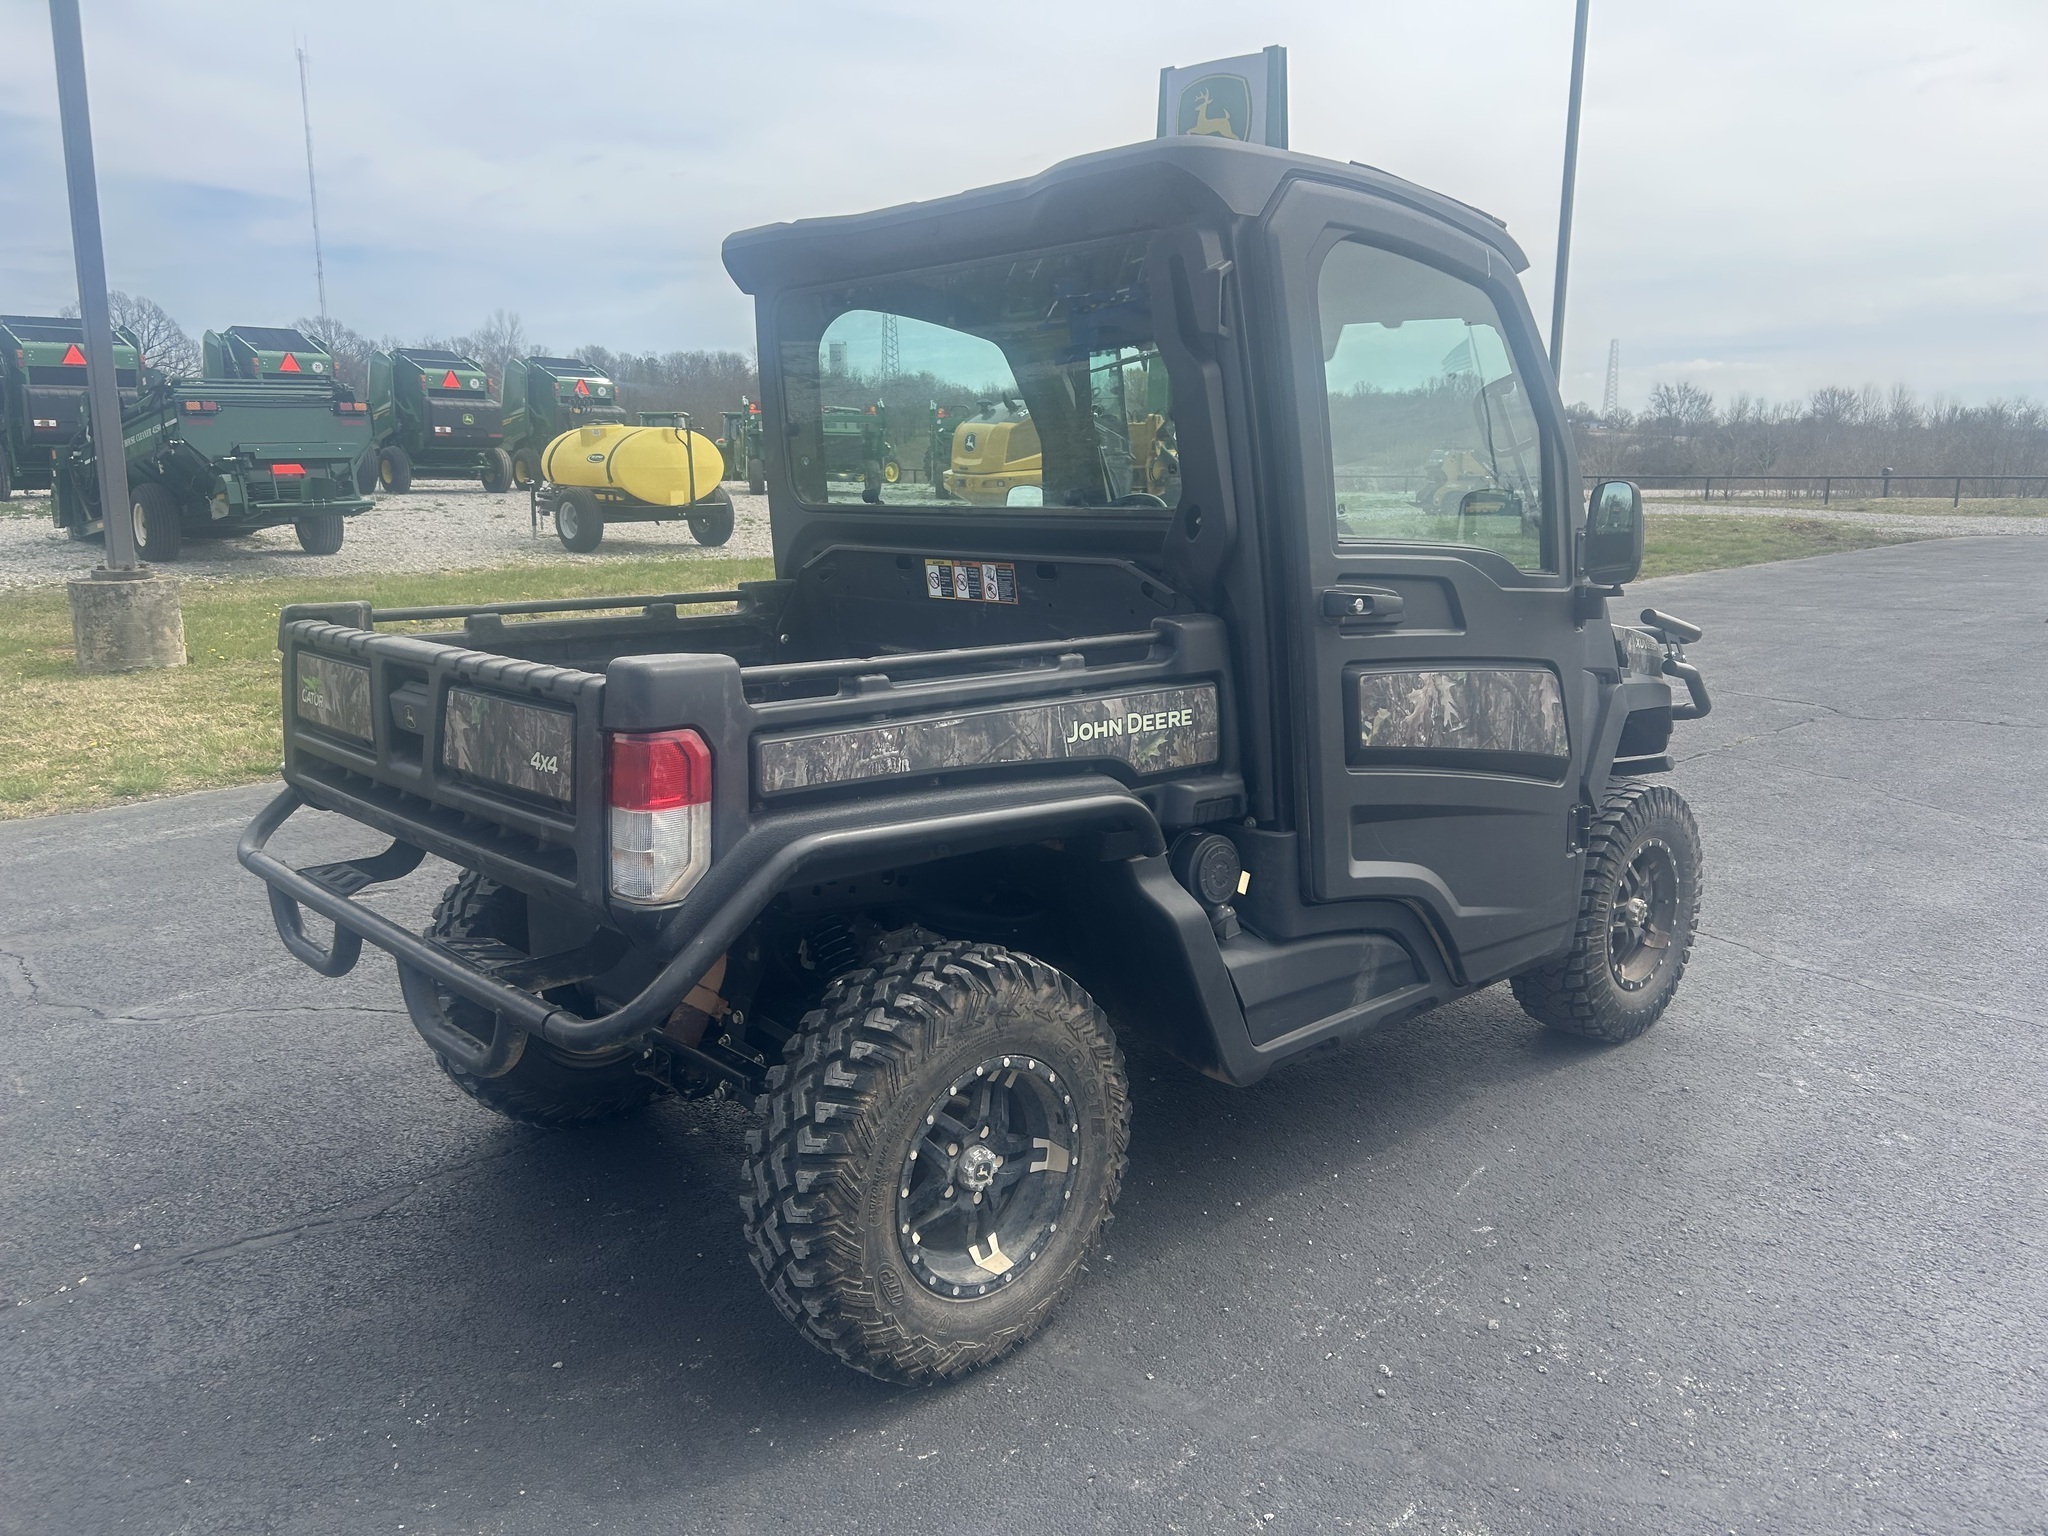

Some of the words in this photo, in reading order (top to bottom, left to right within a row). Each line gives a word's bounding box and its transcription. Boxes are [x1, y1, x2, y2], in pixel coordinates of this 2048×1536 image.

[302, 688, 323, 708] GATOR
[1067, 718, 1123, 744] JOHN
[1127, 708, 1193, 734] DEERE
[1055, 1037, 1107, 1137] COYOTE
[881, 1270, 904, 1304] ITP
